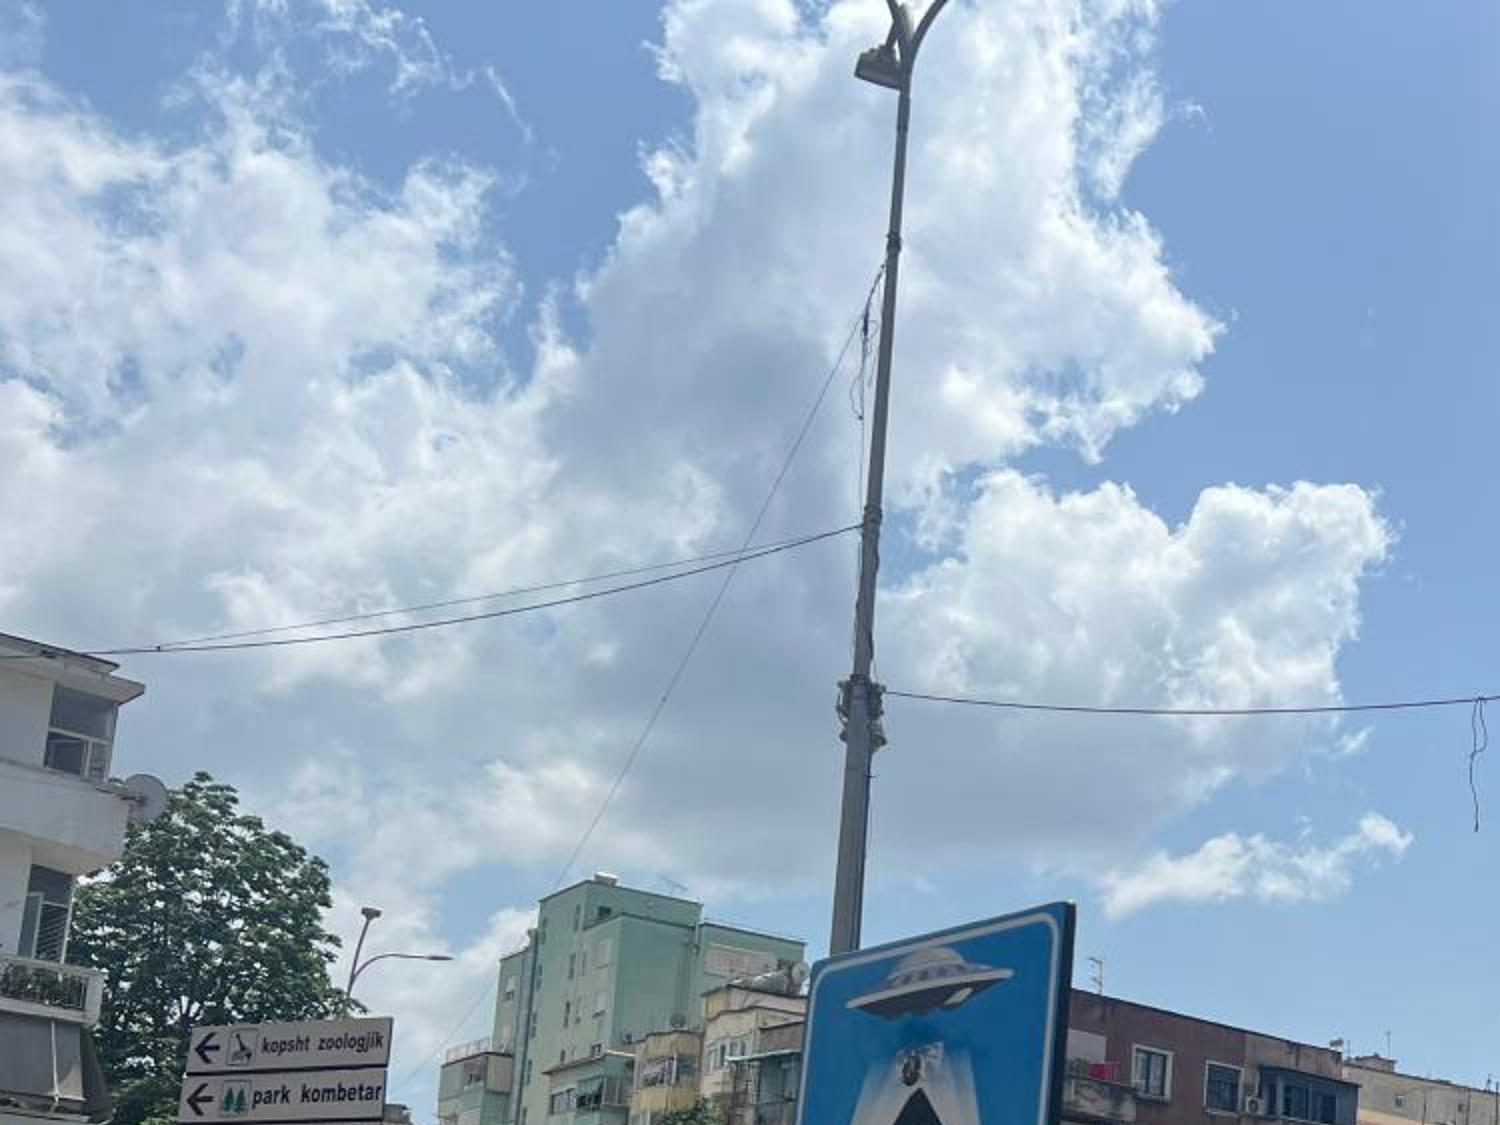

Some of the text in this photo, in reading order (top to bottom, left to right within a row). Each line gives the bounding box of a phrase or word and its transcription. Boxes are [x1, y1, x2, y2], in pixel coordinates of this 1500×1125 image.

[261, 1031, 385, 1056] kopsht zoologjik
[251, 1083, 383, 1109] park kombetar
